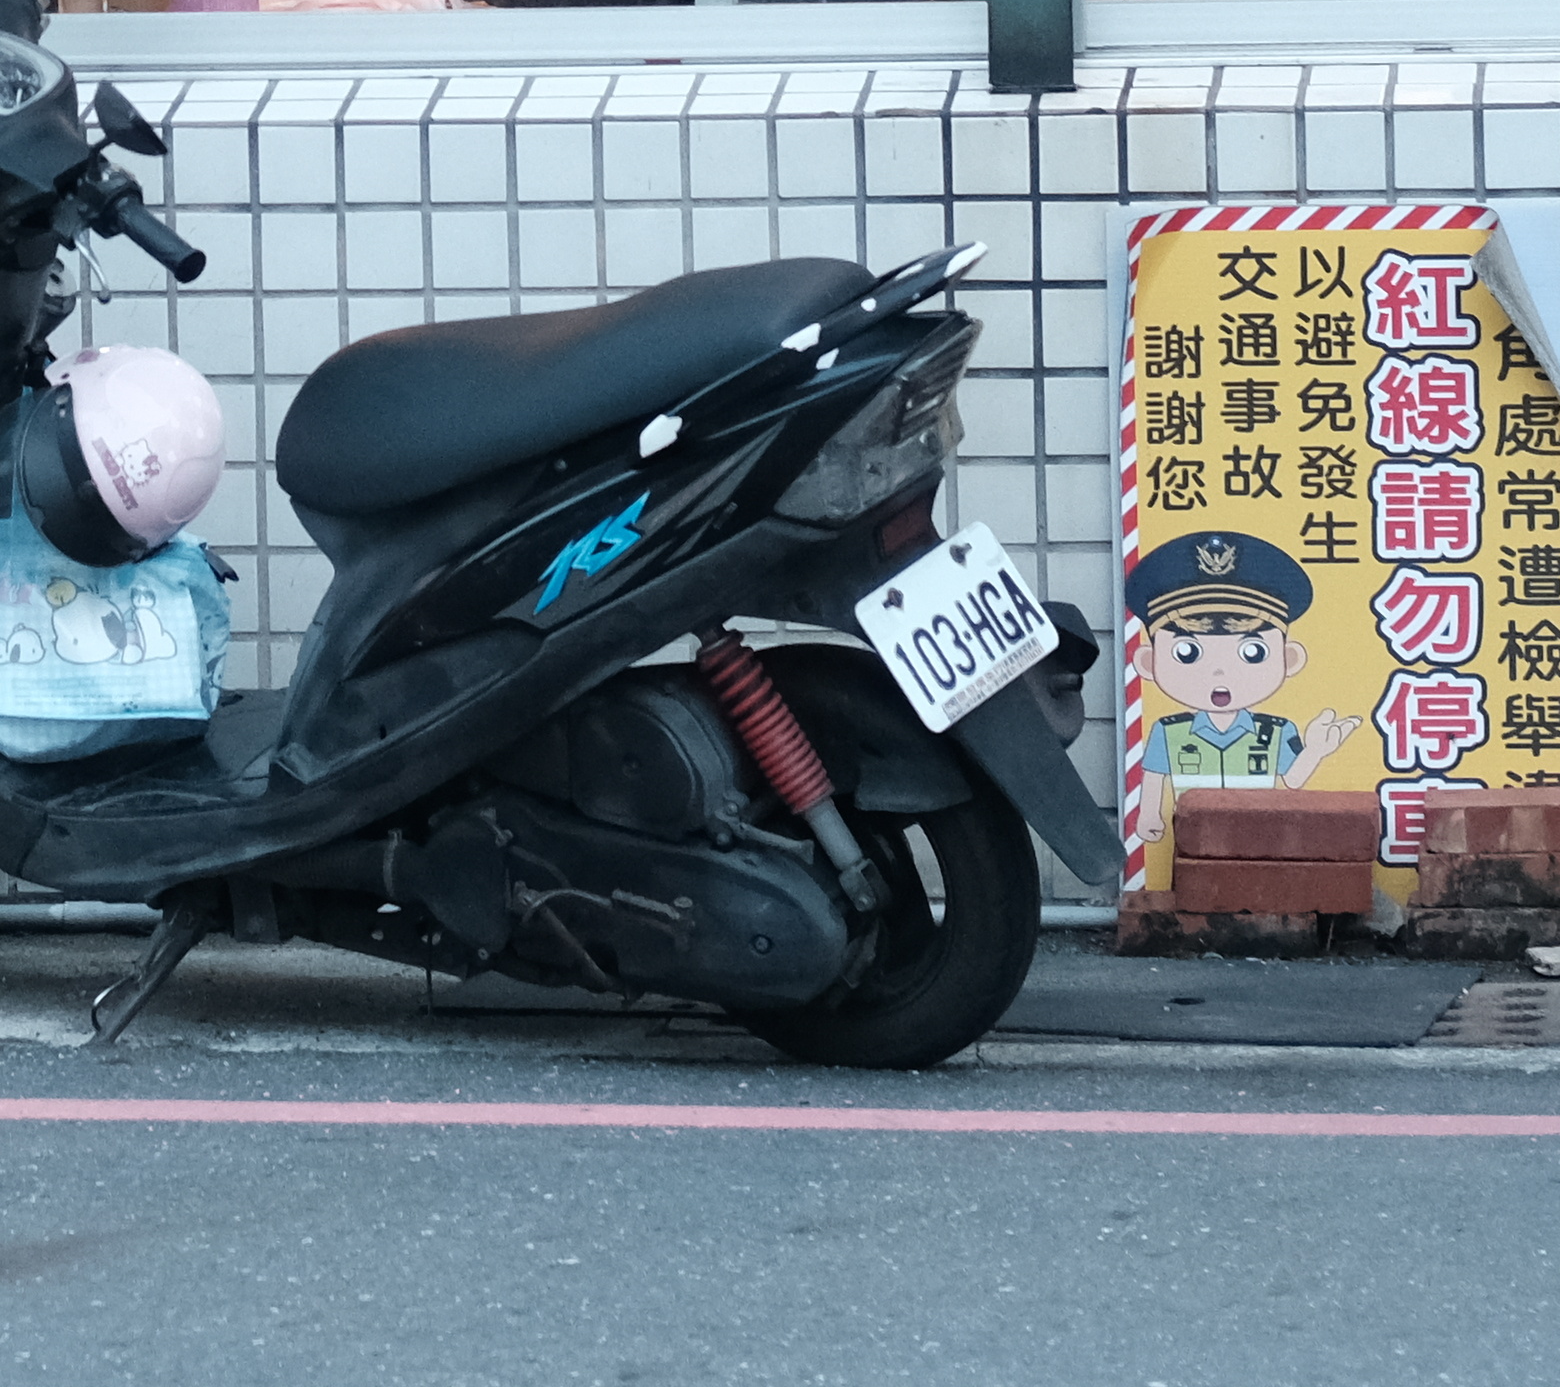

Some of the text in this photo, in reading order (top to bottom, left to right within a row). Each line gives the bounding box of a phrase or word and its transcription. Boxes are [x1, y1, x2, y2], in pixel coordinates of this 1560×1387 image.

[1143, 323, 1209, 512] 謝謝您
[1217, 244, 1283, 501] 交通事故
[1293, 244, 1361, 565] 以避免發生
[893, 567, 1046, 706] 103-HGA
